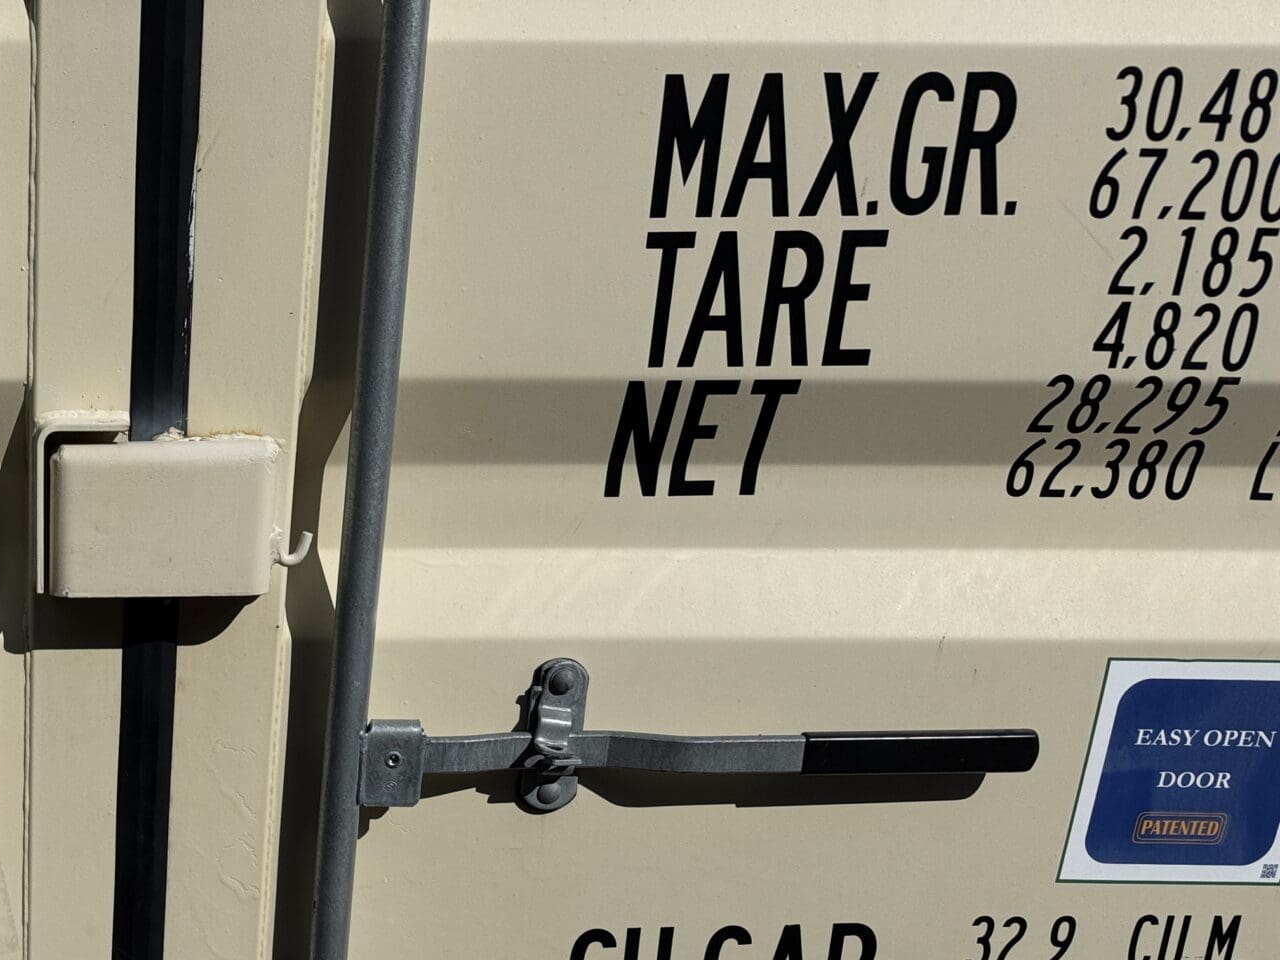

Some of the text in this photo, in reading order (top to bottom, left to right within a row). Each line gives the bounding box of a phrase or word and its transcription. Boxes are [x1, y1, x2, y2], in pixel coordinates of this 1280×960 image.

[649, 71, 1017, 218] MAX.GR.
[645, 225, 1280, 368] TARE 2,185
[1092, 301, 1259, 372] 4,820
[603, 374, 1242, 498] NET 28,295
[1006, 437, 1206, 500] 62,380
[1134, 728, 1278, 748] EASY OPEN
[1156, 771, 1232, 789] DOOR
[1140, 819, 1220, 837] PATENTED
